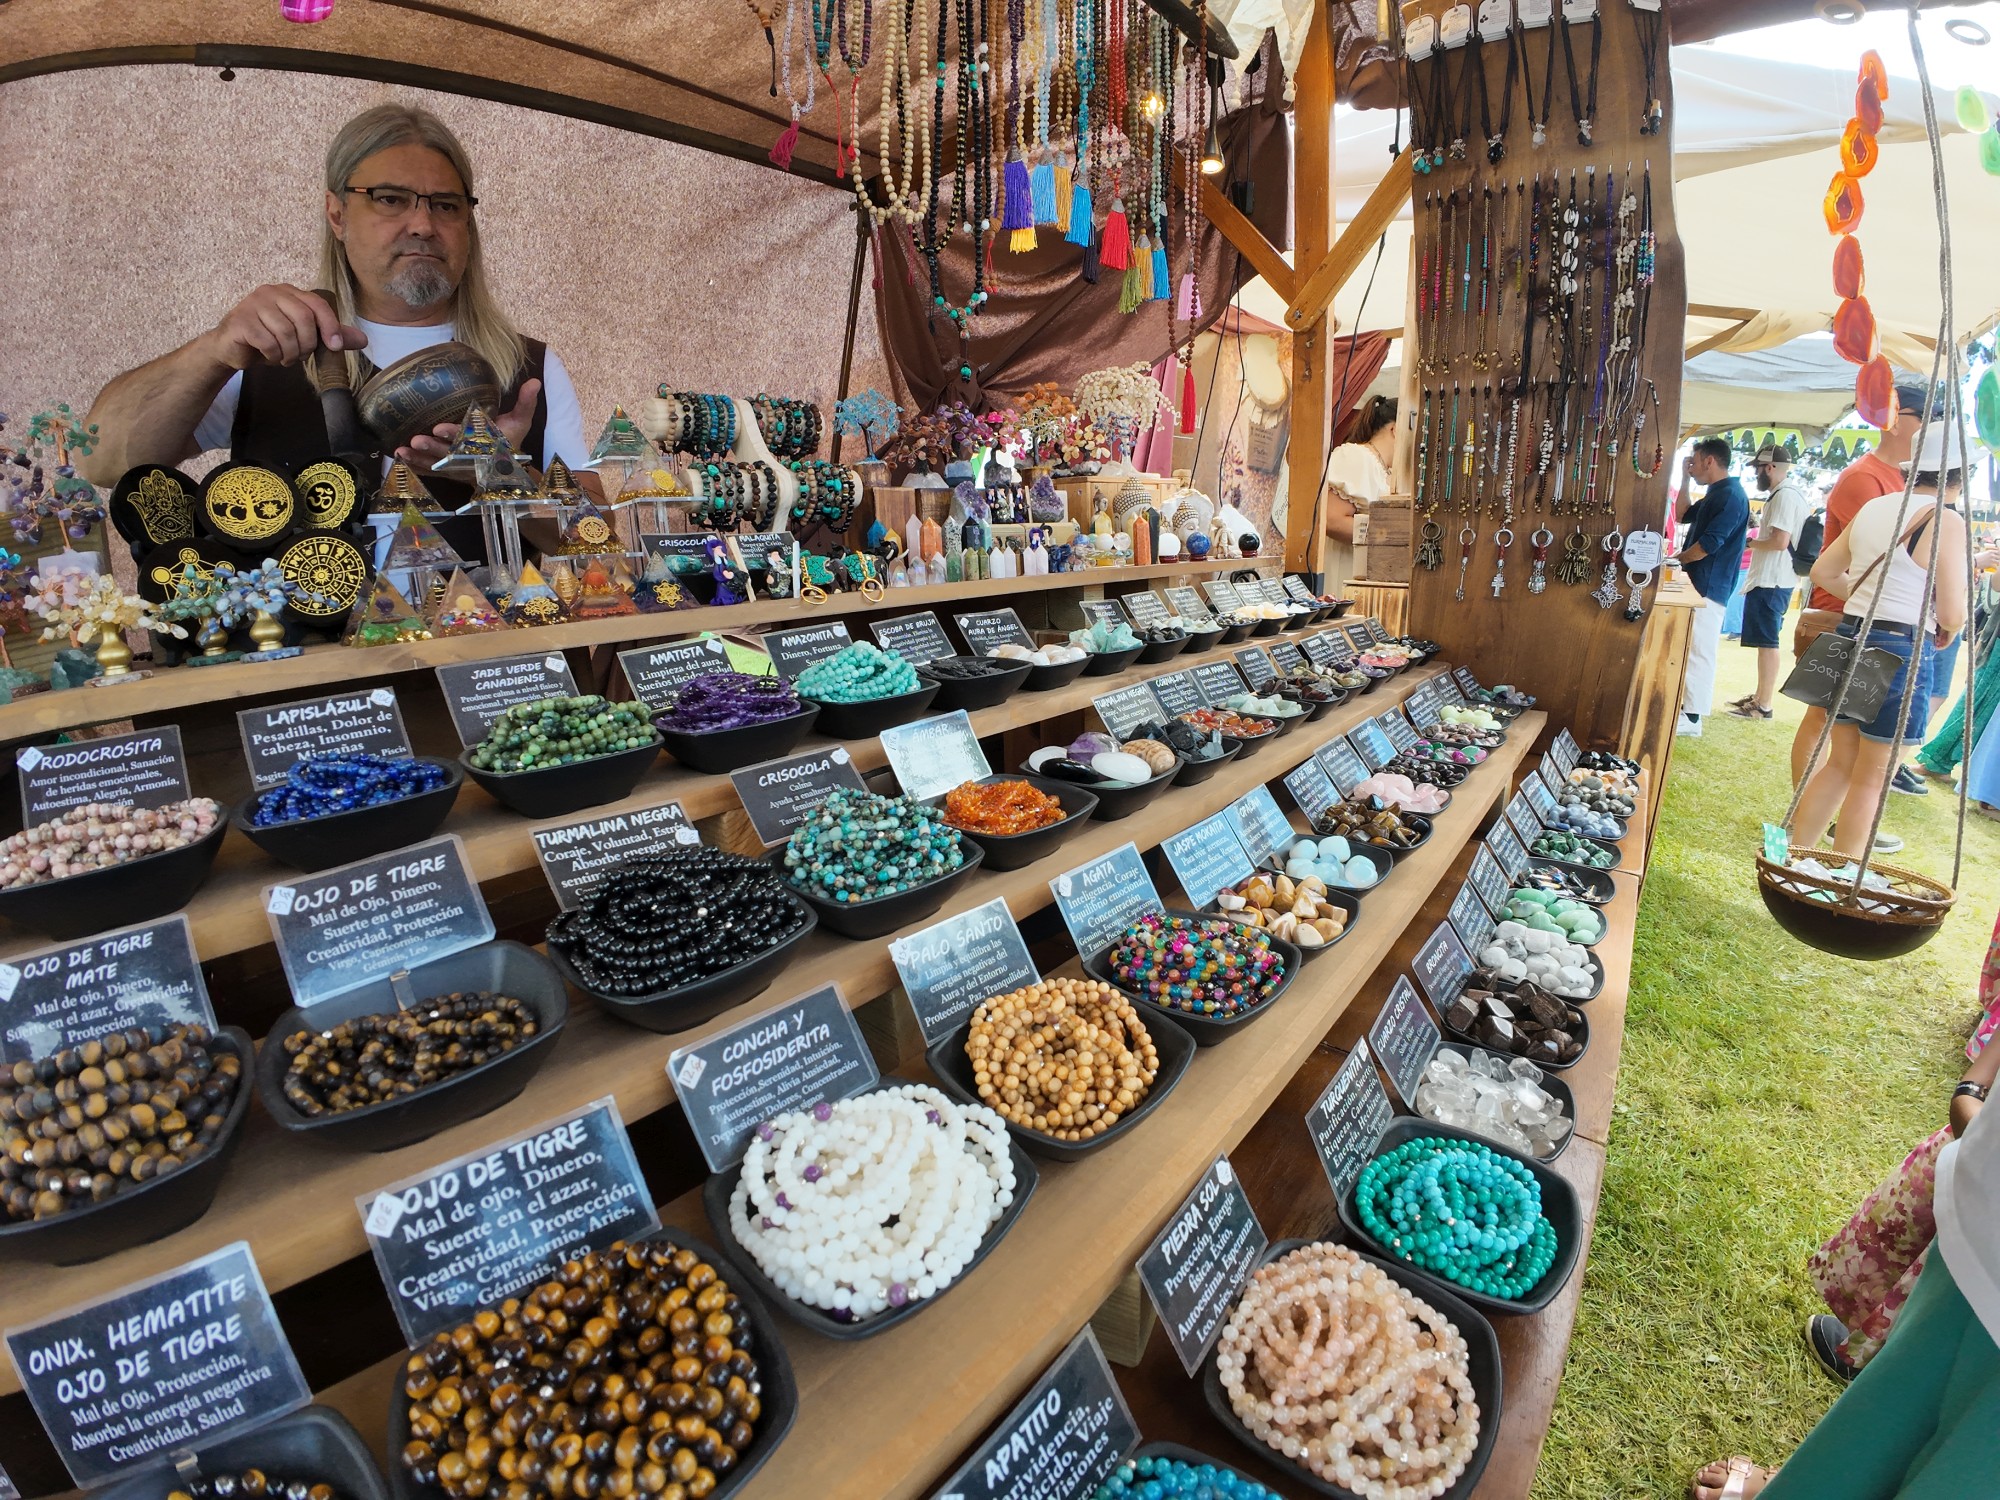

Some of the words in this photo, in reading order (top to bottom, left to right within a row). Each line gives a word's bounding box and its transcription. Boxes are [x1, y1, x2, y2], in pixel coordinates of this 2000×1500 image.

[659, 538, 707, 547] CRISOCOLA
[781, 629, 834, 647] AMAZONITA
[878, 625, 904, 636] ESCOBA
[916, 618, 936, 628] BRUJA
[968, 626, 986, 635] AURA
[975, 618, 1002, 626] CUARZO
[471, 666, 502, 680] JADE
[506, 662, 542, 674] VERDE
[639, 666, 685, 681] Limpieza
[686, 660, 700, 669] del
[701, 658, 723, 667] aura,
[650, 646, 705, 666] AMATISTA
[781, 650, 813, 660] Dinero,
[812, 643, 844, 654] Fortuna,
[475, 673, 546, 691] CANADIENSE
[637, 679, 672, 692] Sueños
[1127, 686, 1147, 698] NEGRA
[252, 723, 328, 745] Pesadillas,
[331, 716, 372, 730] Dolor
[266, 696, 372, 727] LAPISLÁZULI
[40, 737, 162, 770] RODOCROSITA
[318, 727, 392, 745] Insomnio,
[59, 762, 129, 783] incondicional,
[98, 769, 163, 788] emocionales,
[758, 759, 830, 787] CRISOCOLA
[31, 794, 92, 812] Autoestima,
[535, 816, 629, 848] TURMALINA
[630, 804, 683, 827] NEGRA
[592, 830, 653, 852] Voluntad,
[1174, 835, 1196, 856] JASPE
[571, 853, 622, 872] Absorbe
[293, 886, 341, 913] OJO
[350, 874, 378, 896] DE
[386, 854, 447, 883] TIGRE
[308, 907, 338, 927] Mal
[340, 905, 358, 917] de
[359, 896, 390, 915] Ojo,
[391, 881, 442, 903] Dinero,
[1067, 880, 1116, 909] Inteligencia,
[1114, 866, 1140, 884] Coraje
[1069, 897, 1108, 924] Equilibrio
[1108, 874, 1148, 902] emocional,
[322, 920, 370, 941] Suerte
[371, 914, 389, 925] en
[391, 906, 404, 919] el
[406, 897, 439, 915] azar,
[1087, 893, 1141, 928] Concentración
[306, 928, 392, 964] Creatividad,
[392, 905, 464, 936] Protección
[361, 935, 423, 961] Capricornio,
[911, 940, 950, 969] PALO
[957, 916, 1002, 947] SANTO
[23, 956, 61, 979] OJO
[68, 948, 93, 968] DE
[100, 932, 154, 958] TIGRE
[962, 956, 996, 976] negativas
[65, 962, 119, 991] MATE
[924, 999, 970, 1028] Protección,
[983, 965, 1030, 995] Tranquilidad
[6, 1023, 46, 1043] Suerte
[80, 1004, 113, 1022] azar,
[114, 980, 194, 1012] Creatividad,
[33, 999, 60, 1017] Mal
[61, 995, 77, 1008] de
[66, 1016, 137, 1043] Protección
[722, 1020, 788, 1064] CONCHA
[1377, 1015, 1396, 1053] CUARZO
[711, 1023, 830, 1096] FOSFOSIDERITA
[776, 1078, 801, 1098] Alivia
[801, 1055, 841, 1080] Ansiedad,
[710, 1115, 760, 1146] Depresión
[801, 1060, 859, 1096] Concentración
[1318, 1090, 1358, 1146] Purificación,
[1355, 1064, 1373, 1091] Suerte,
[1323, 1120, 1353, 1159] Riqueza,
[1351, 1078, 1378, 1120] Cansancio,
[399, 1172, 460, 1215] OJO
[467, 1152, 507, 1189] DE
[507, 1118, 588, 1172] TIGRE
[1332, 1129, 1360, 1168] Energía,
[402, 1212, 449, 1244] Mal
[450, 1202, 476, 1223] de
[480, 1185, 522, 1213] ojo,
[522, 1150, 604, 1191] Dinero,
[398, 1230, 528, 1299] Creatividad,
[529, 1180, 637, 1239] Protección
[423, 1222, 493, 1261] Suerte
[496, 1209, 524, 1229] en
[527, 1194, 547, 1214] el
[549, 1177, 598, 1205] azar,
[1161, 1202, 1203, 1266] PIEDRA
[1199, 1179, 1220, 1212] SOL
[412, 1280, 475, 1313] Virgo,
[476, 1228, 587, 1284] Capricornio,
[588, 1205, 636, 1233] Aries,
[1164, 1233, 1212, 1297] Protección,
[1208, 1191, 1235, 1232] Energía
[477, 1260, 558, 1306] Géminis,
[1178, 1269, 1226, 1342] Autoestima,
[1221, 1217, 1254, 1271] Esperanza
[1188, 1258, 1215, 1294] física,
[28, 1336, 96, 1376] ONIX.
[106, 1273, 247, 1351] HEMATITE
[56, 1368, 107, 1404] OJO
[116, 1350, 151, 1384] DE
[160, 1313, 242, 1365] TIGRE
[70, 1402, 101, 1427] Mal
[102, 1398, 121, 1414] de
[120, 1390, 156, 1410] Ojo,
[154, 1353, 248, 1398] Protección,
[70, 1422, 127, 1452] Absorbe
[127, 1416, 144, 1432] la
[144, 1394, 202, 1427] energía
[203, 1364, 272, 1404] negativa
[108, 1418, 199, 1463] Creatividad,
[198, 1398, 246, 1430] Salud
[1076, 1389, 1113, 1442] Viaje
[985, 1388, 1061, 1490] APATITO
[1096, 1450, 1118, 1480] Leo
